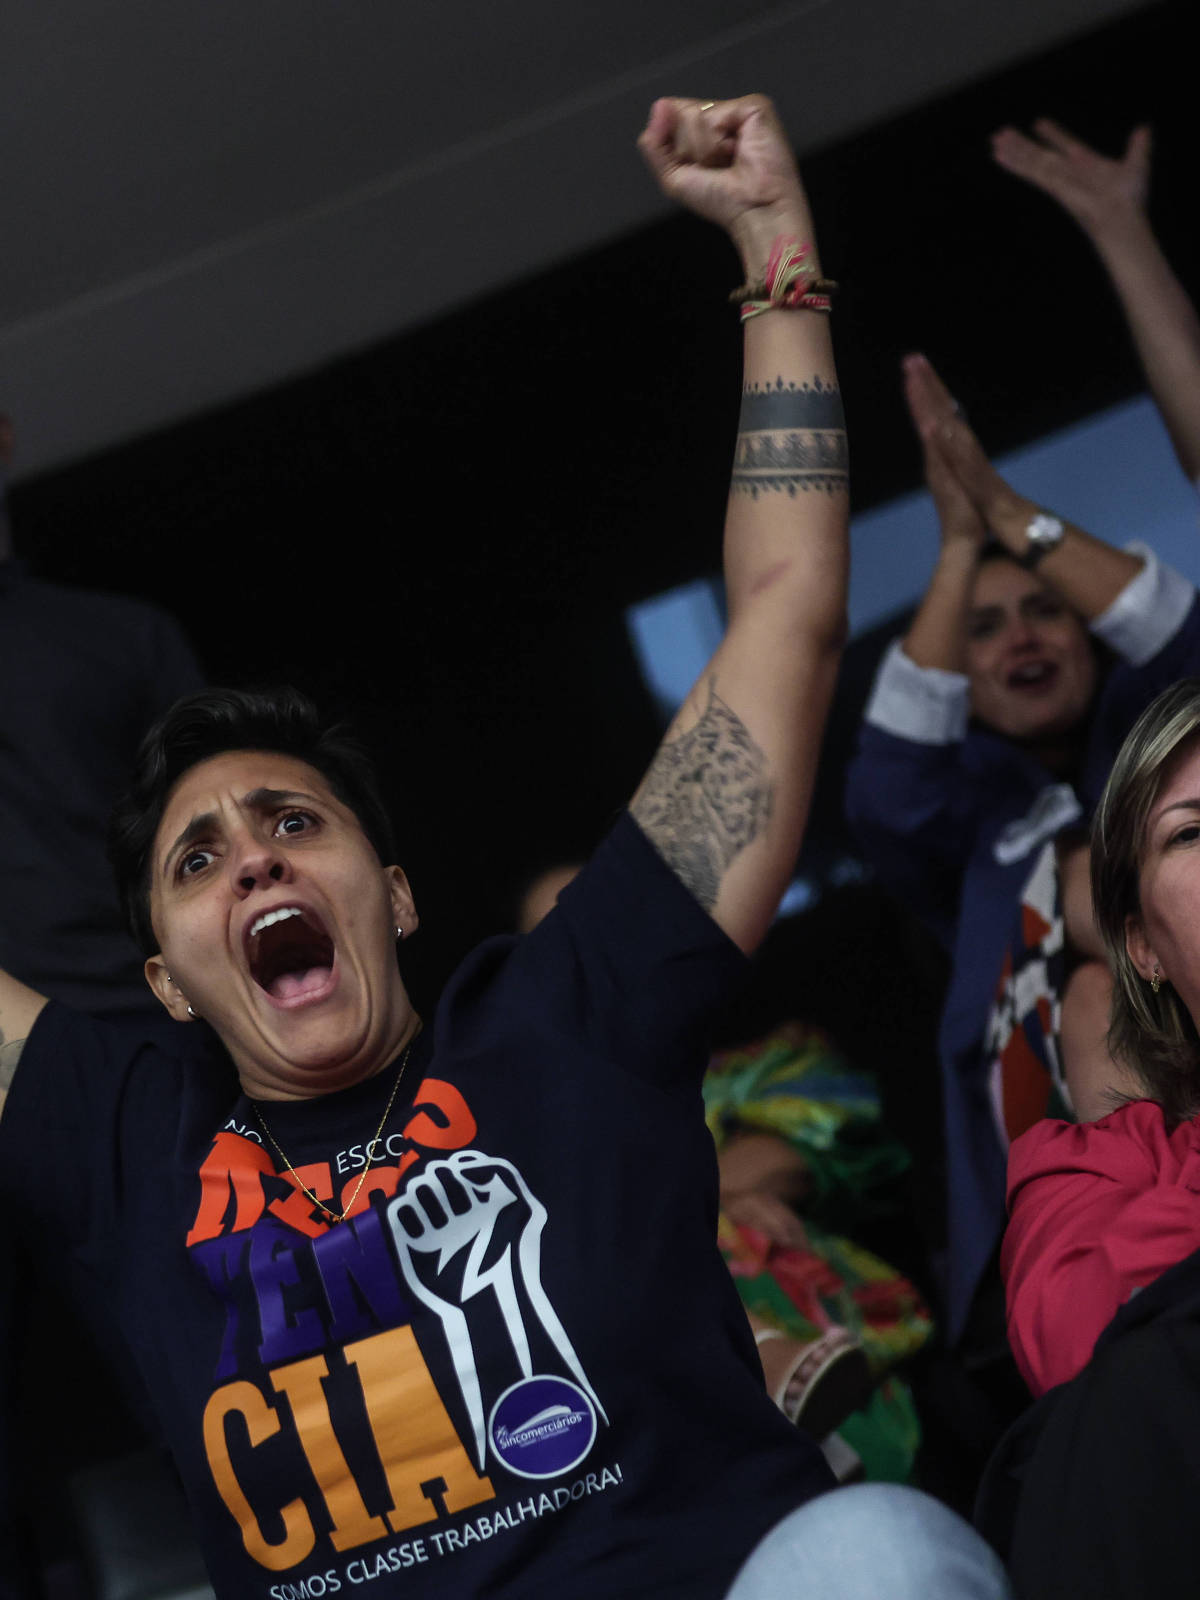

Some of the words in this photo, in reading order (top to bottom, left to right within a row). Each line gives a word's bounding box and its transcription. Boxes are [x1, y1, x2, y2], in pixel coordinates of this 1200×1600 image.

[202, 1324, 497, 1572] CIA
[269, 1569, 343, 1600] SOMOS
[346, 1539, 430, 1585] CLASSE
[431, 1463, 625, 1556] TRABALHADORA!
